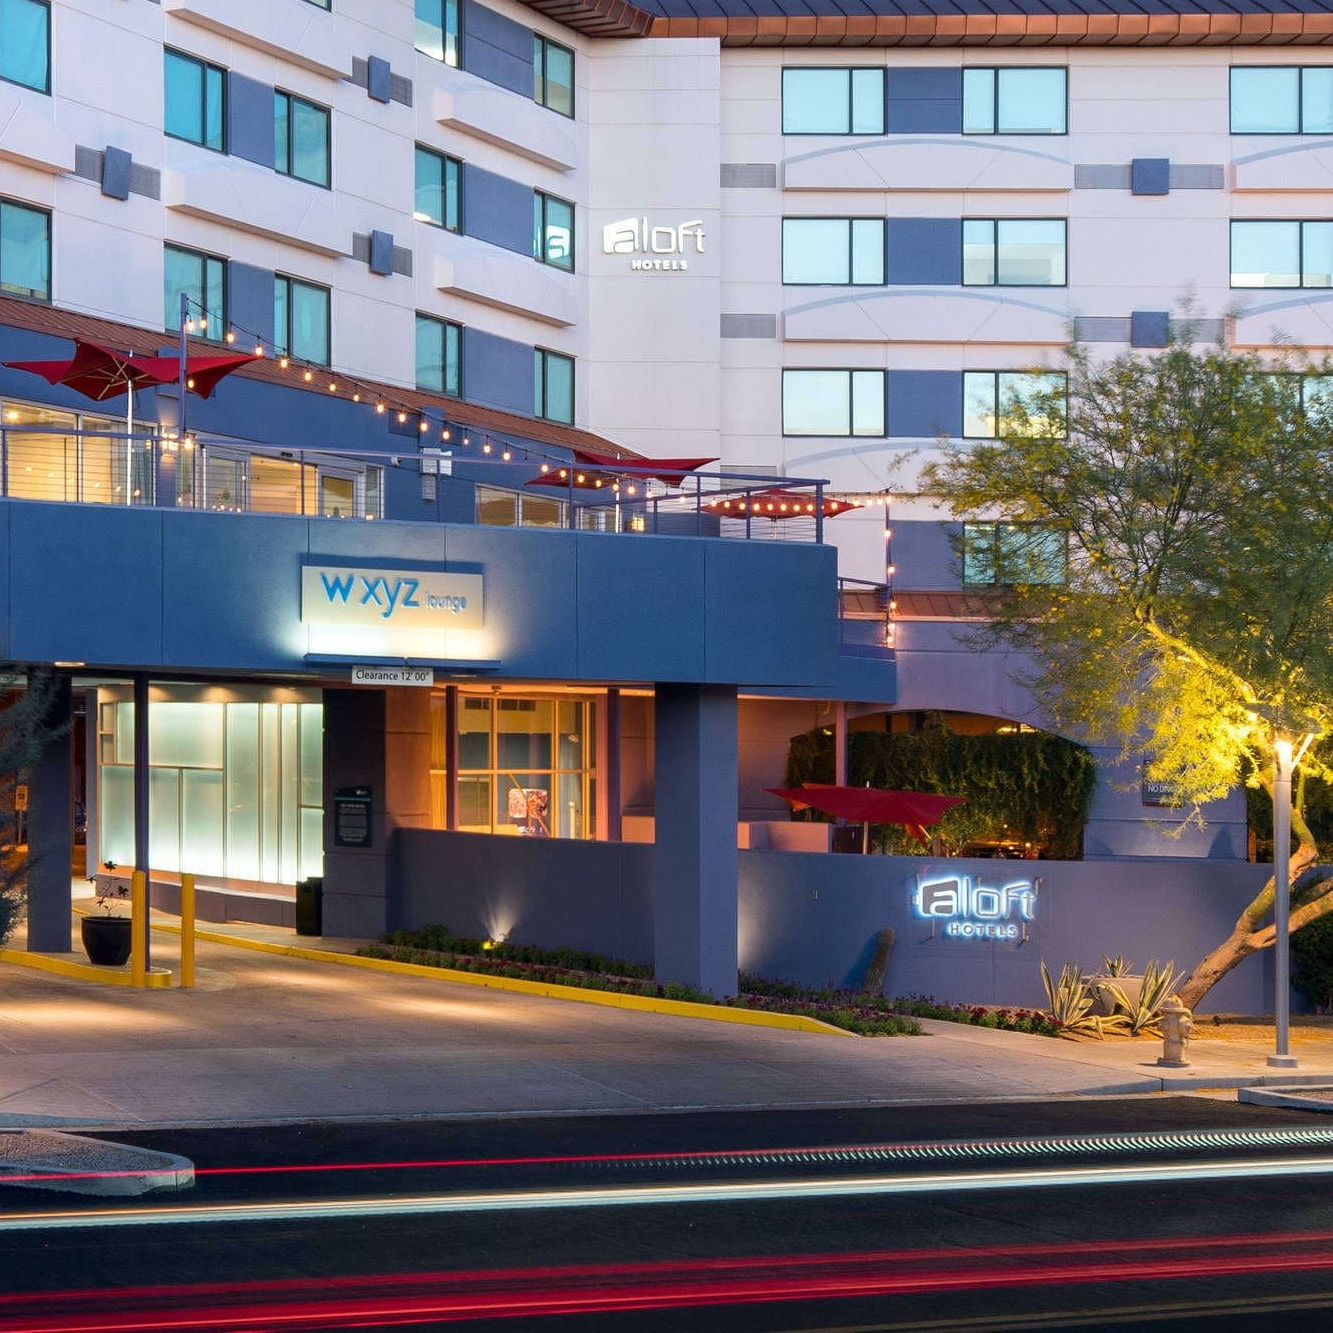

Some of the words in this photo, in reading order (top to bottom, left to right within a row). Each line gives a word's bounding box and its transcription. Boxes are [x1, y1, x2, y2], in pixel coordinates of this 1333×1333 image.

[603, 217, 705, 254] aloft
[632, 259, 688, 271] HOTELS
[426, 592, 467, 614] lounge
[356, 669, 398, 680] Clearance
[921, 877, 1035, 919] aloft
[949, 923, 1018, 937] HOTELS
